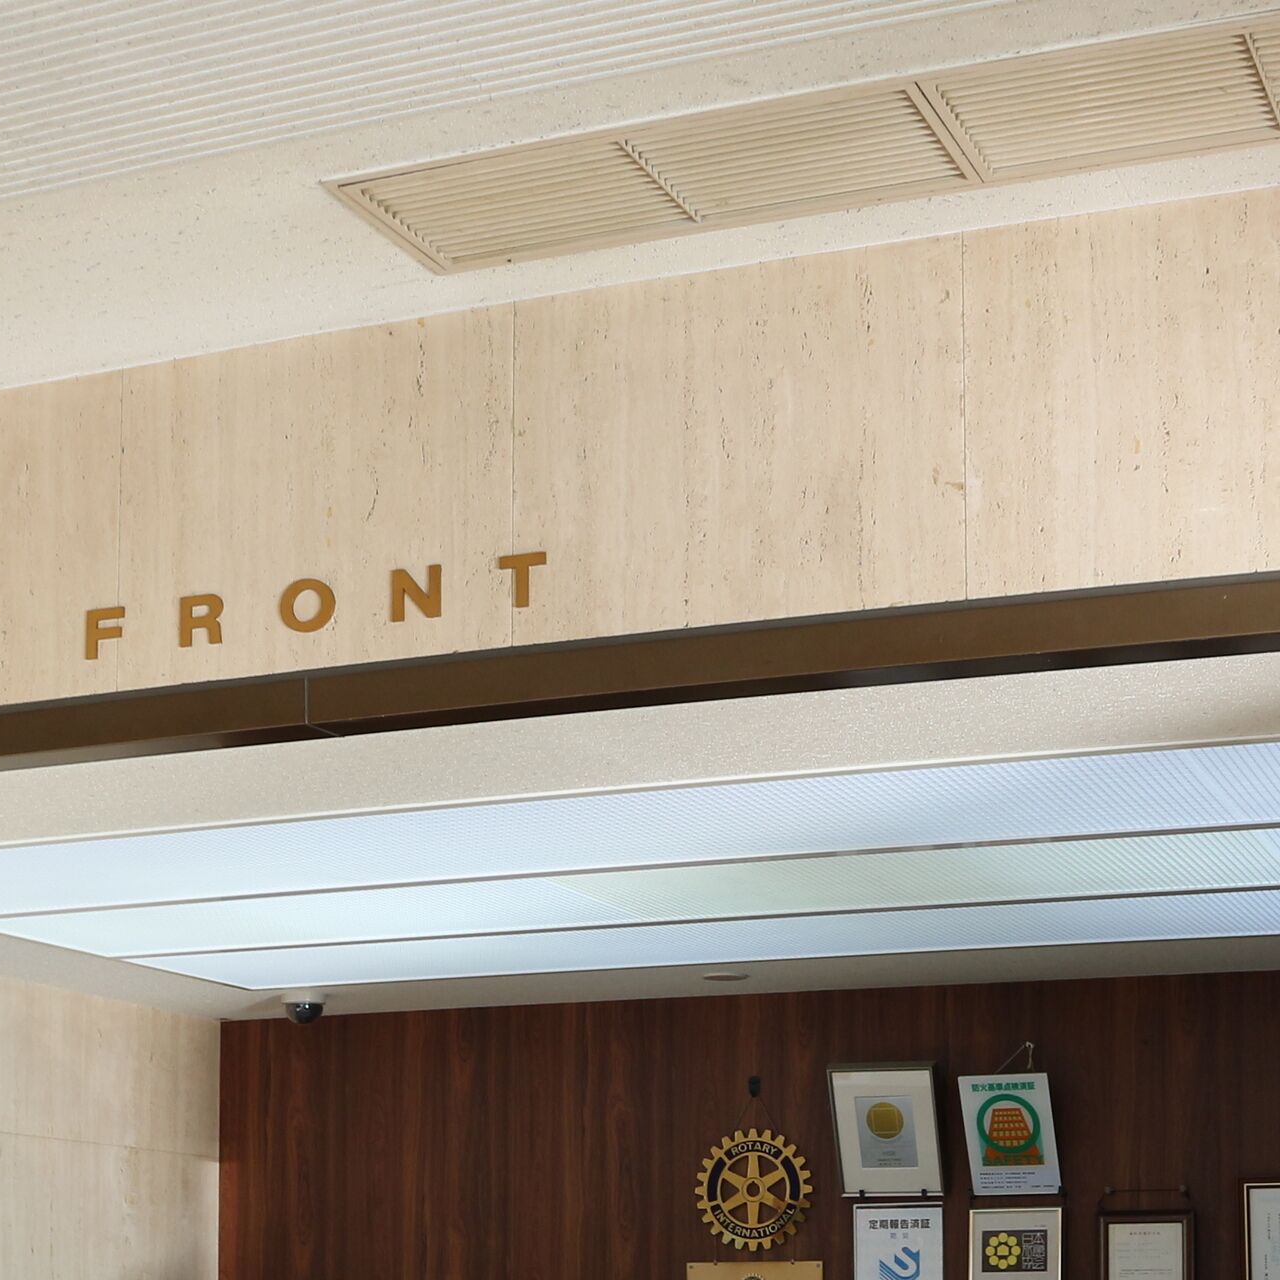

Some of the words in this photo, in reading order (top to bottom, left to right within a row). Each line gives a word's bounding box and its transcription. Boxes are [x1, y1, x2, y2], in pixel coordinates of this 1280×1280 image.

[86, 552, 547, 660] FRONT
[731, 1141, 779, 1157] ROTARY
[714, 1207, 796, 1239] INTERNATIONAL
[869, 1218, 931, 1230] 定期報告済証
